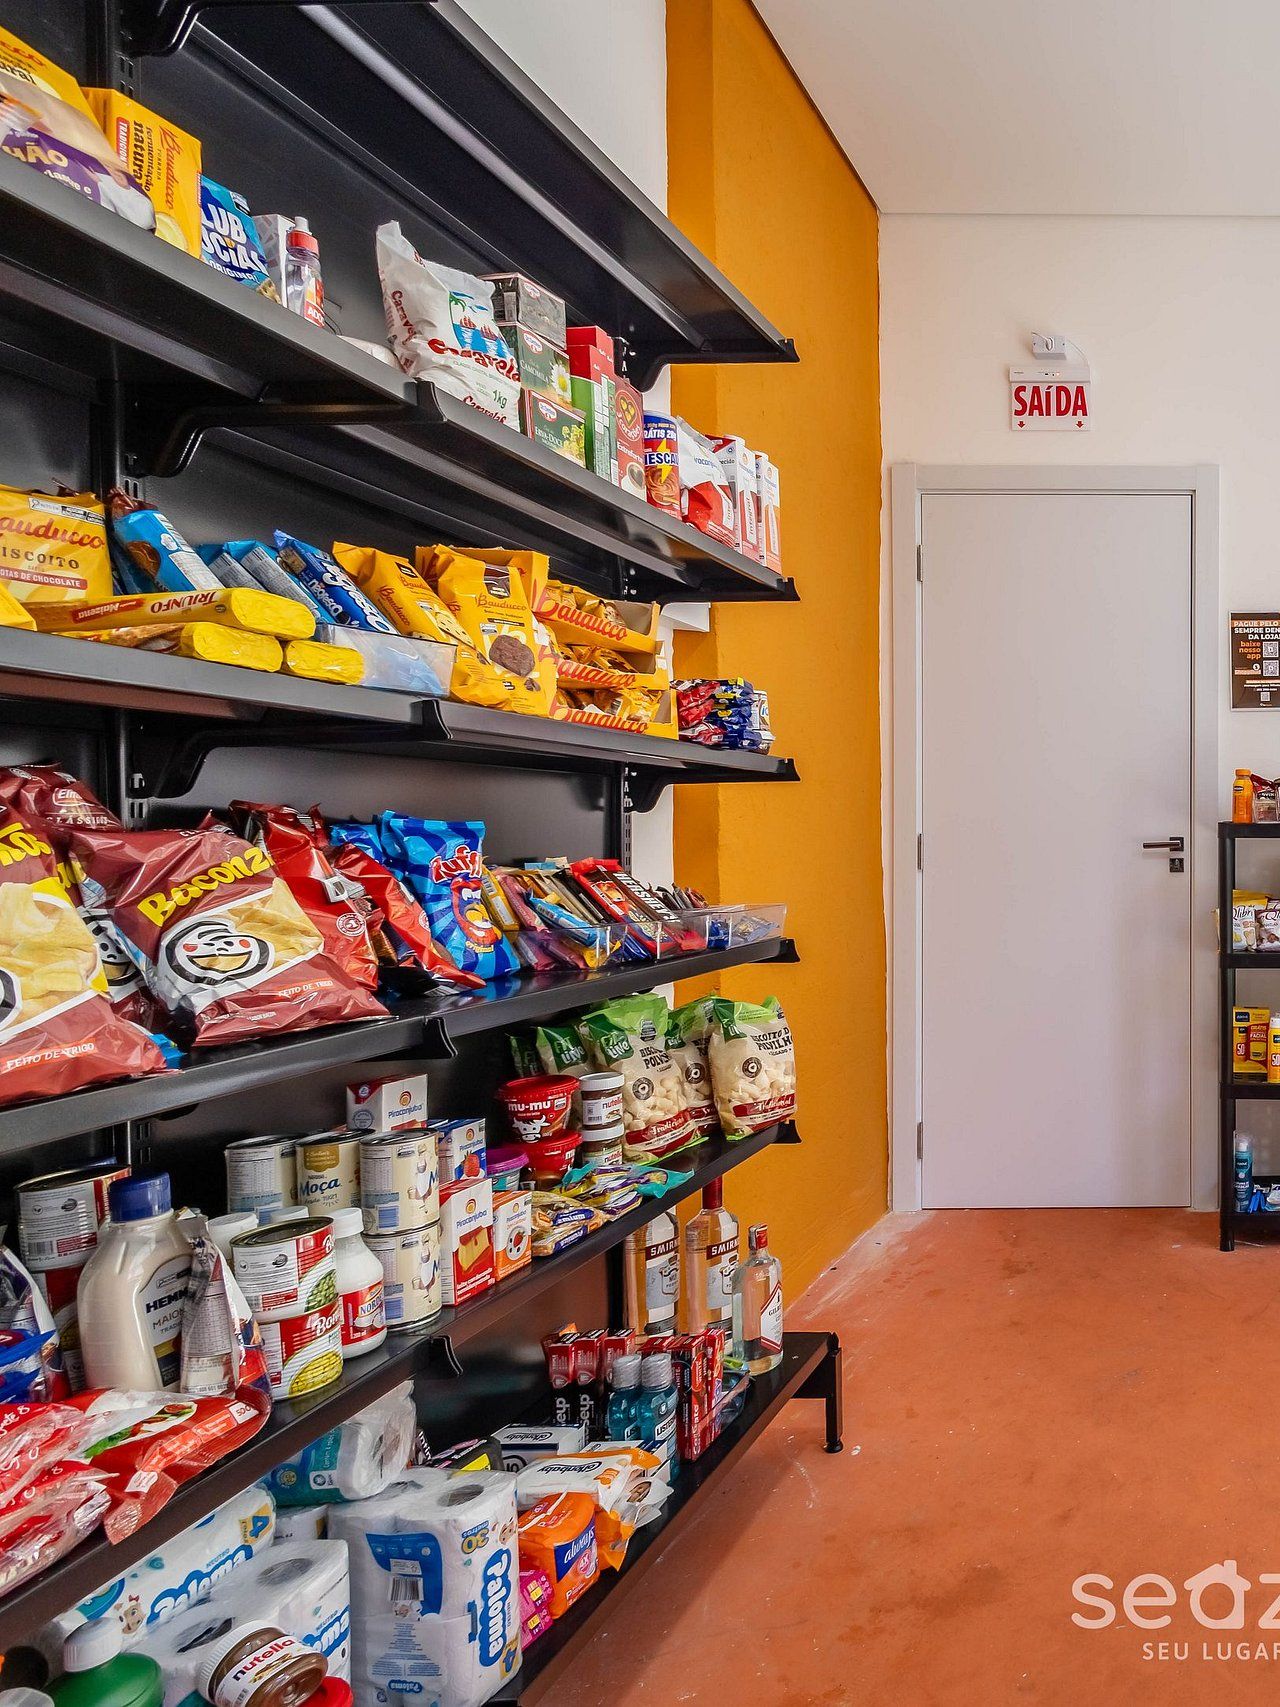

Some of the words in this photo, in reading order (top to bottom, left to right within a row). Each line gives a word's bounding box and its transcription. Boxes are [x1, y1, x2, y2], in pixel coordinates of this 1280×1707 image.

[1013, 385, 1088, 417] SAÍDA
[2, 546, 80, 570] ISCOITO
[20, 571, 32, 581] DE
[33, 574, 82, 588] CHOCOLATE
[151, 589, 220, 614] TRIUNFO
[475, 593, 528, 612] Bauducco
[300, 1176, 341, 1198] Moça
[487, 1553, 508, 1658] Paloma
[232, 1638, 296, 1682] nutella
